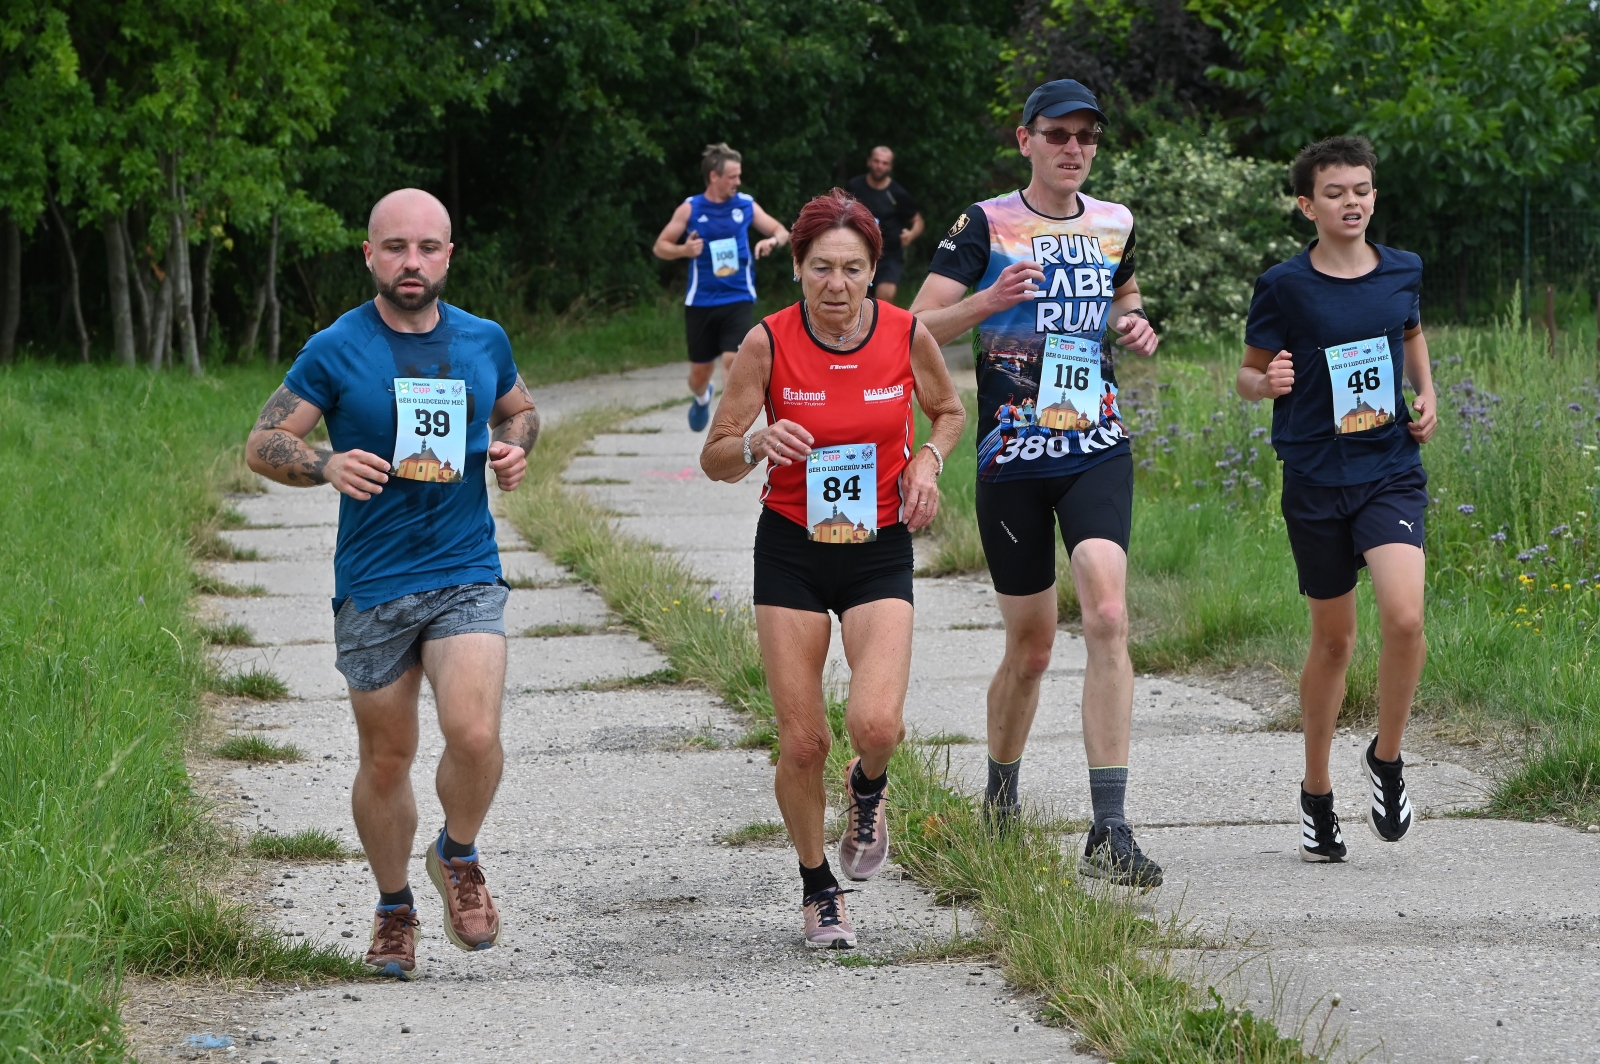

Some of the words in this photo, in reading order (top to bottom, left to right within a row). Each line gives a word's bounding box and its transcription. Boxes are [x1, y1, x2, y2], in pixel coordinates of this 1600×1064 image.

[1031, 234, 1104, 265] RUN
[1035, 301, 1107, 334] RUN
[863, 384, 904, 396] MARATON
[1054, 364, 1090, 391] 116
[1348, 366, 1381, 394] 46
[783, 387, 826, 401] Krakonoš
[414, 408, 450, 437] 39
[995, 434, 1070, 464] 380
[1077, 422, 1128, 454] KM
[823, 474, 861, 502] 84
